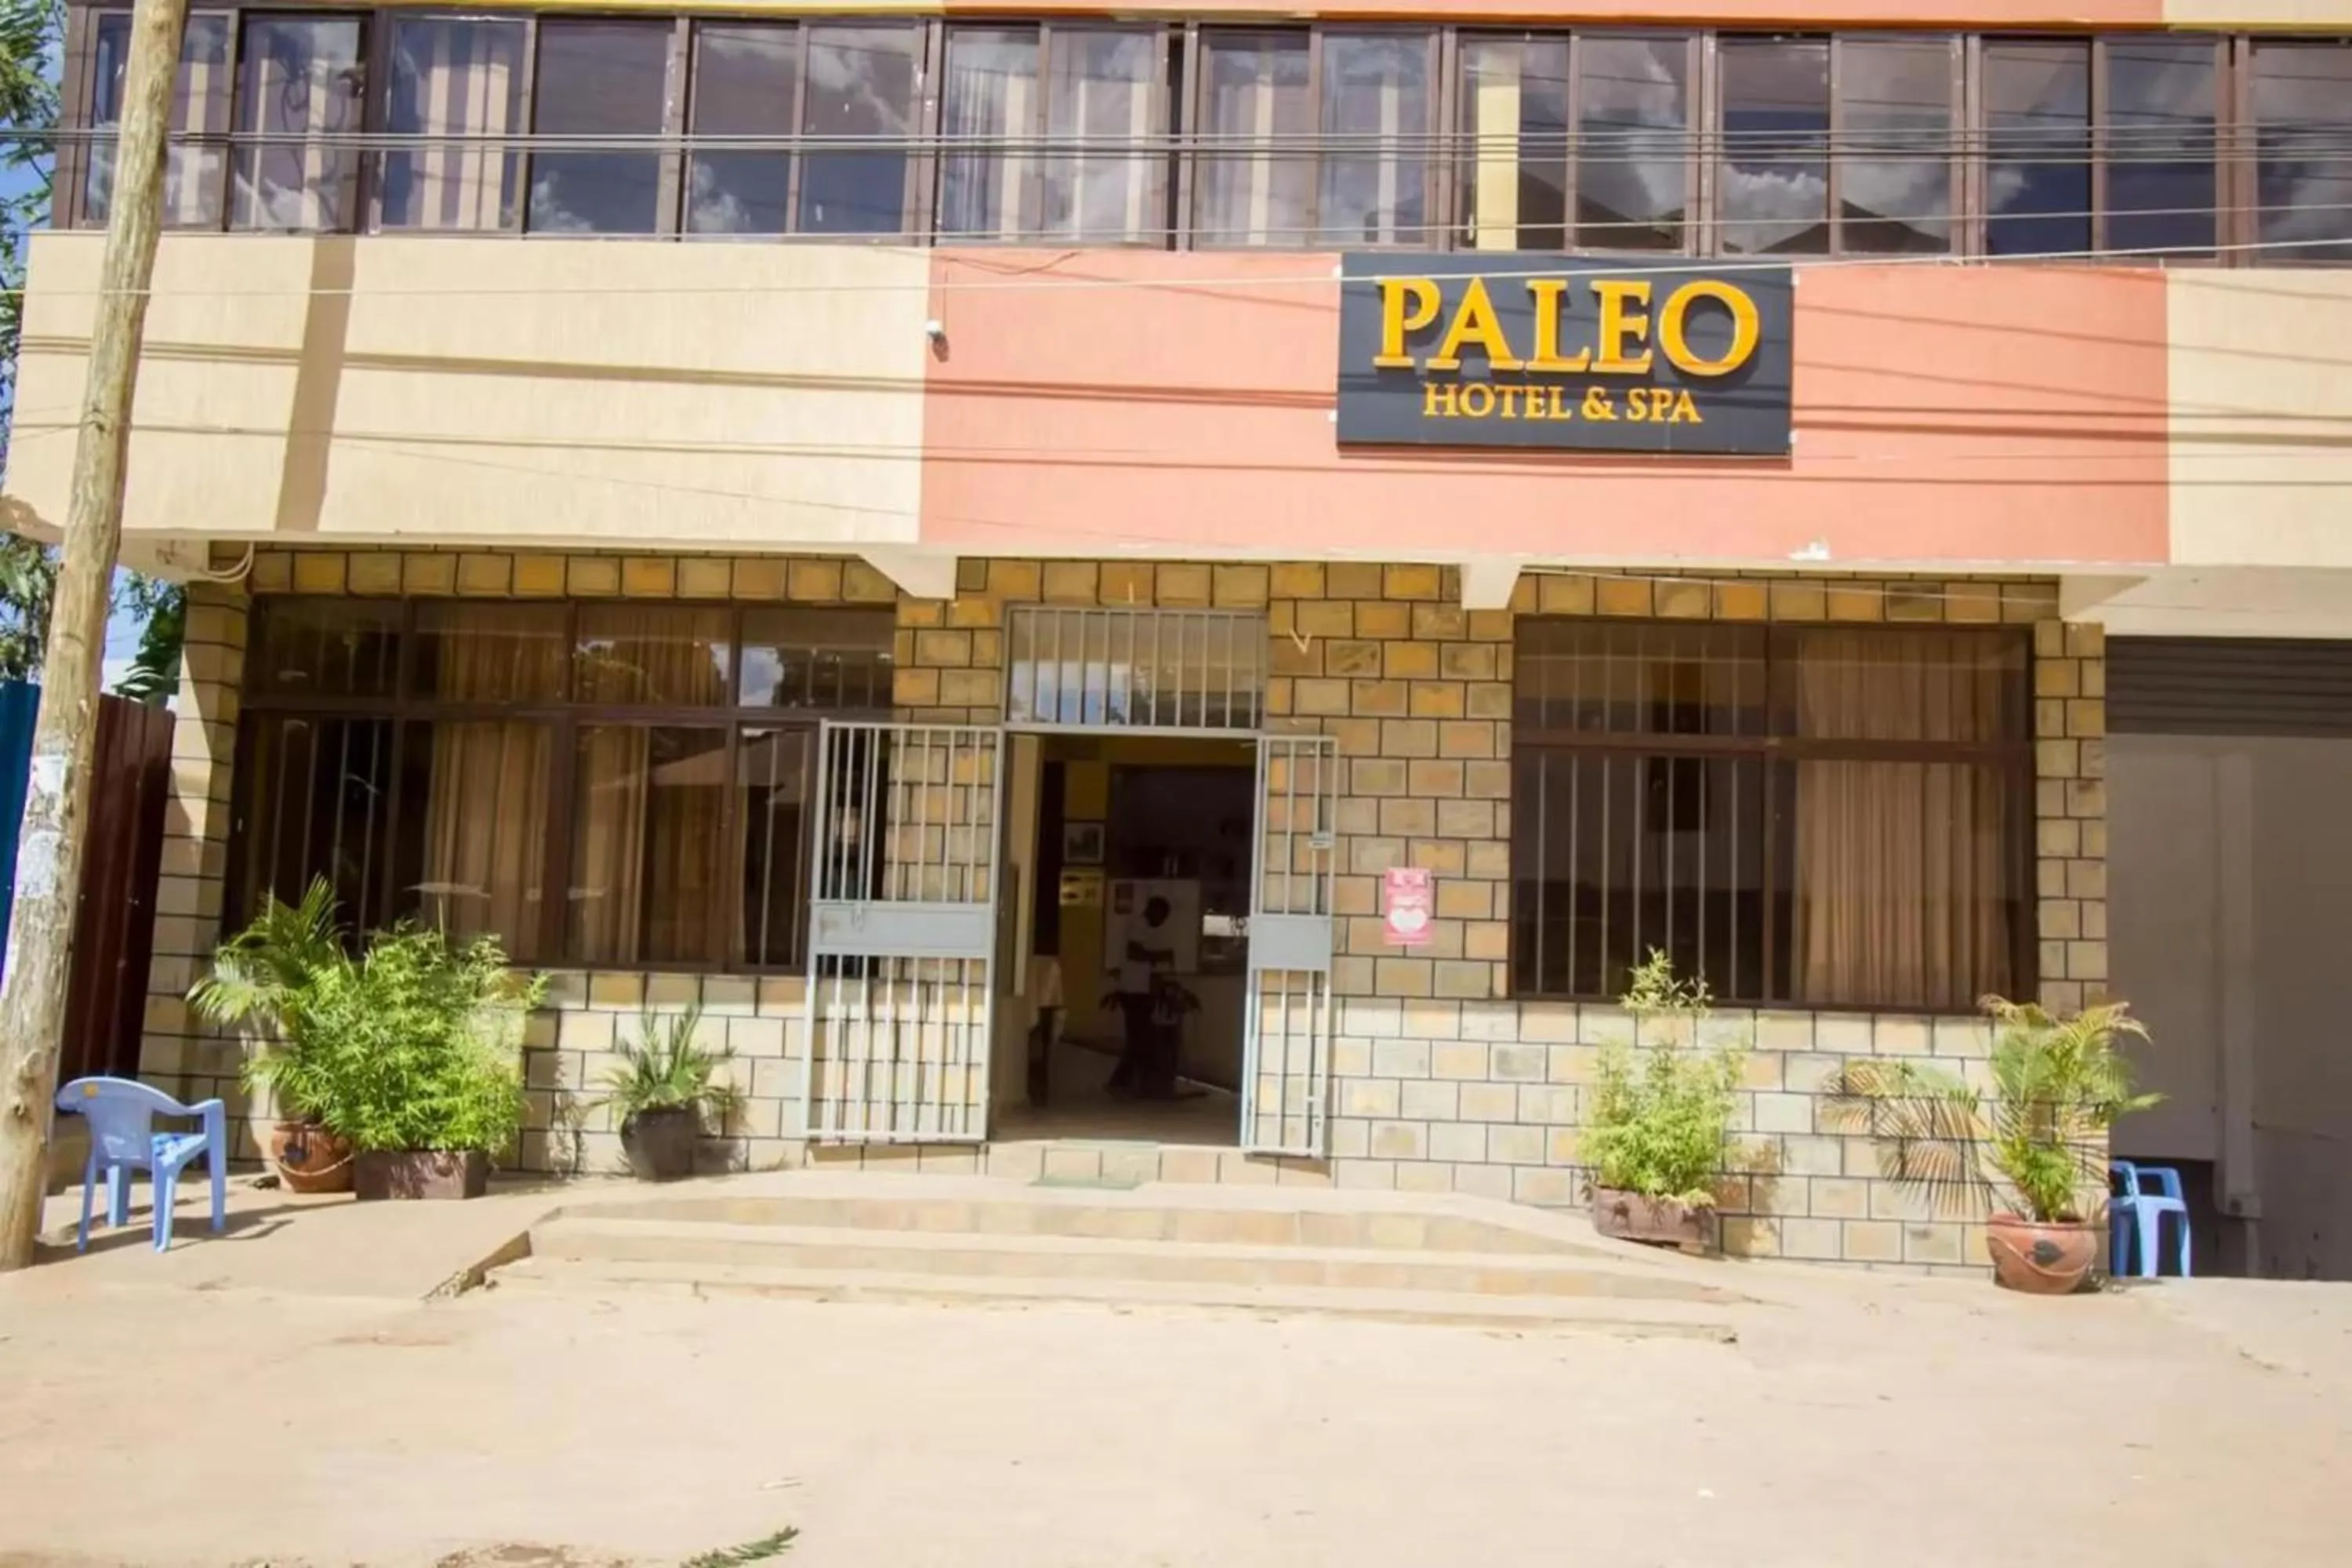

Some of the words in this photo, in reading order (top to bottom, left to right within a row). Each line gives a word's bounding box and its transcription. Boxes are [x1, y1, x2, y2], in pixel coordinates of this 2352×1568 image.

[1372, 276, 1759, 376] PALEO
[1423, 382, 1572, 420] HOTEL
[1581, 387, 1618, 421] &
[1626, 388, 1703, 423] SPA
